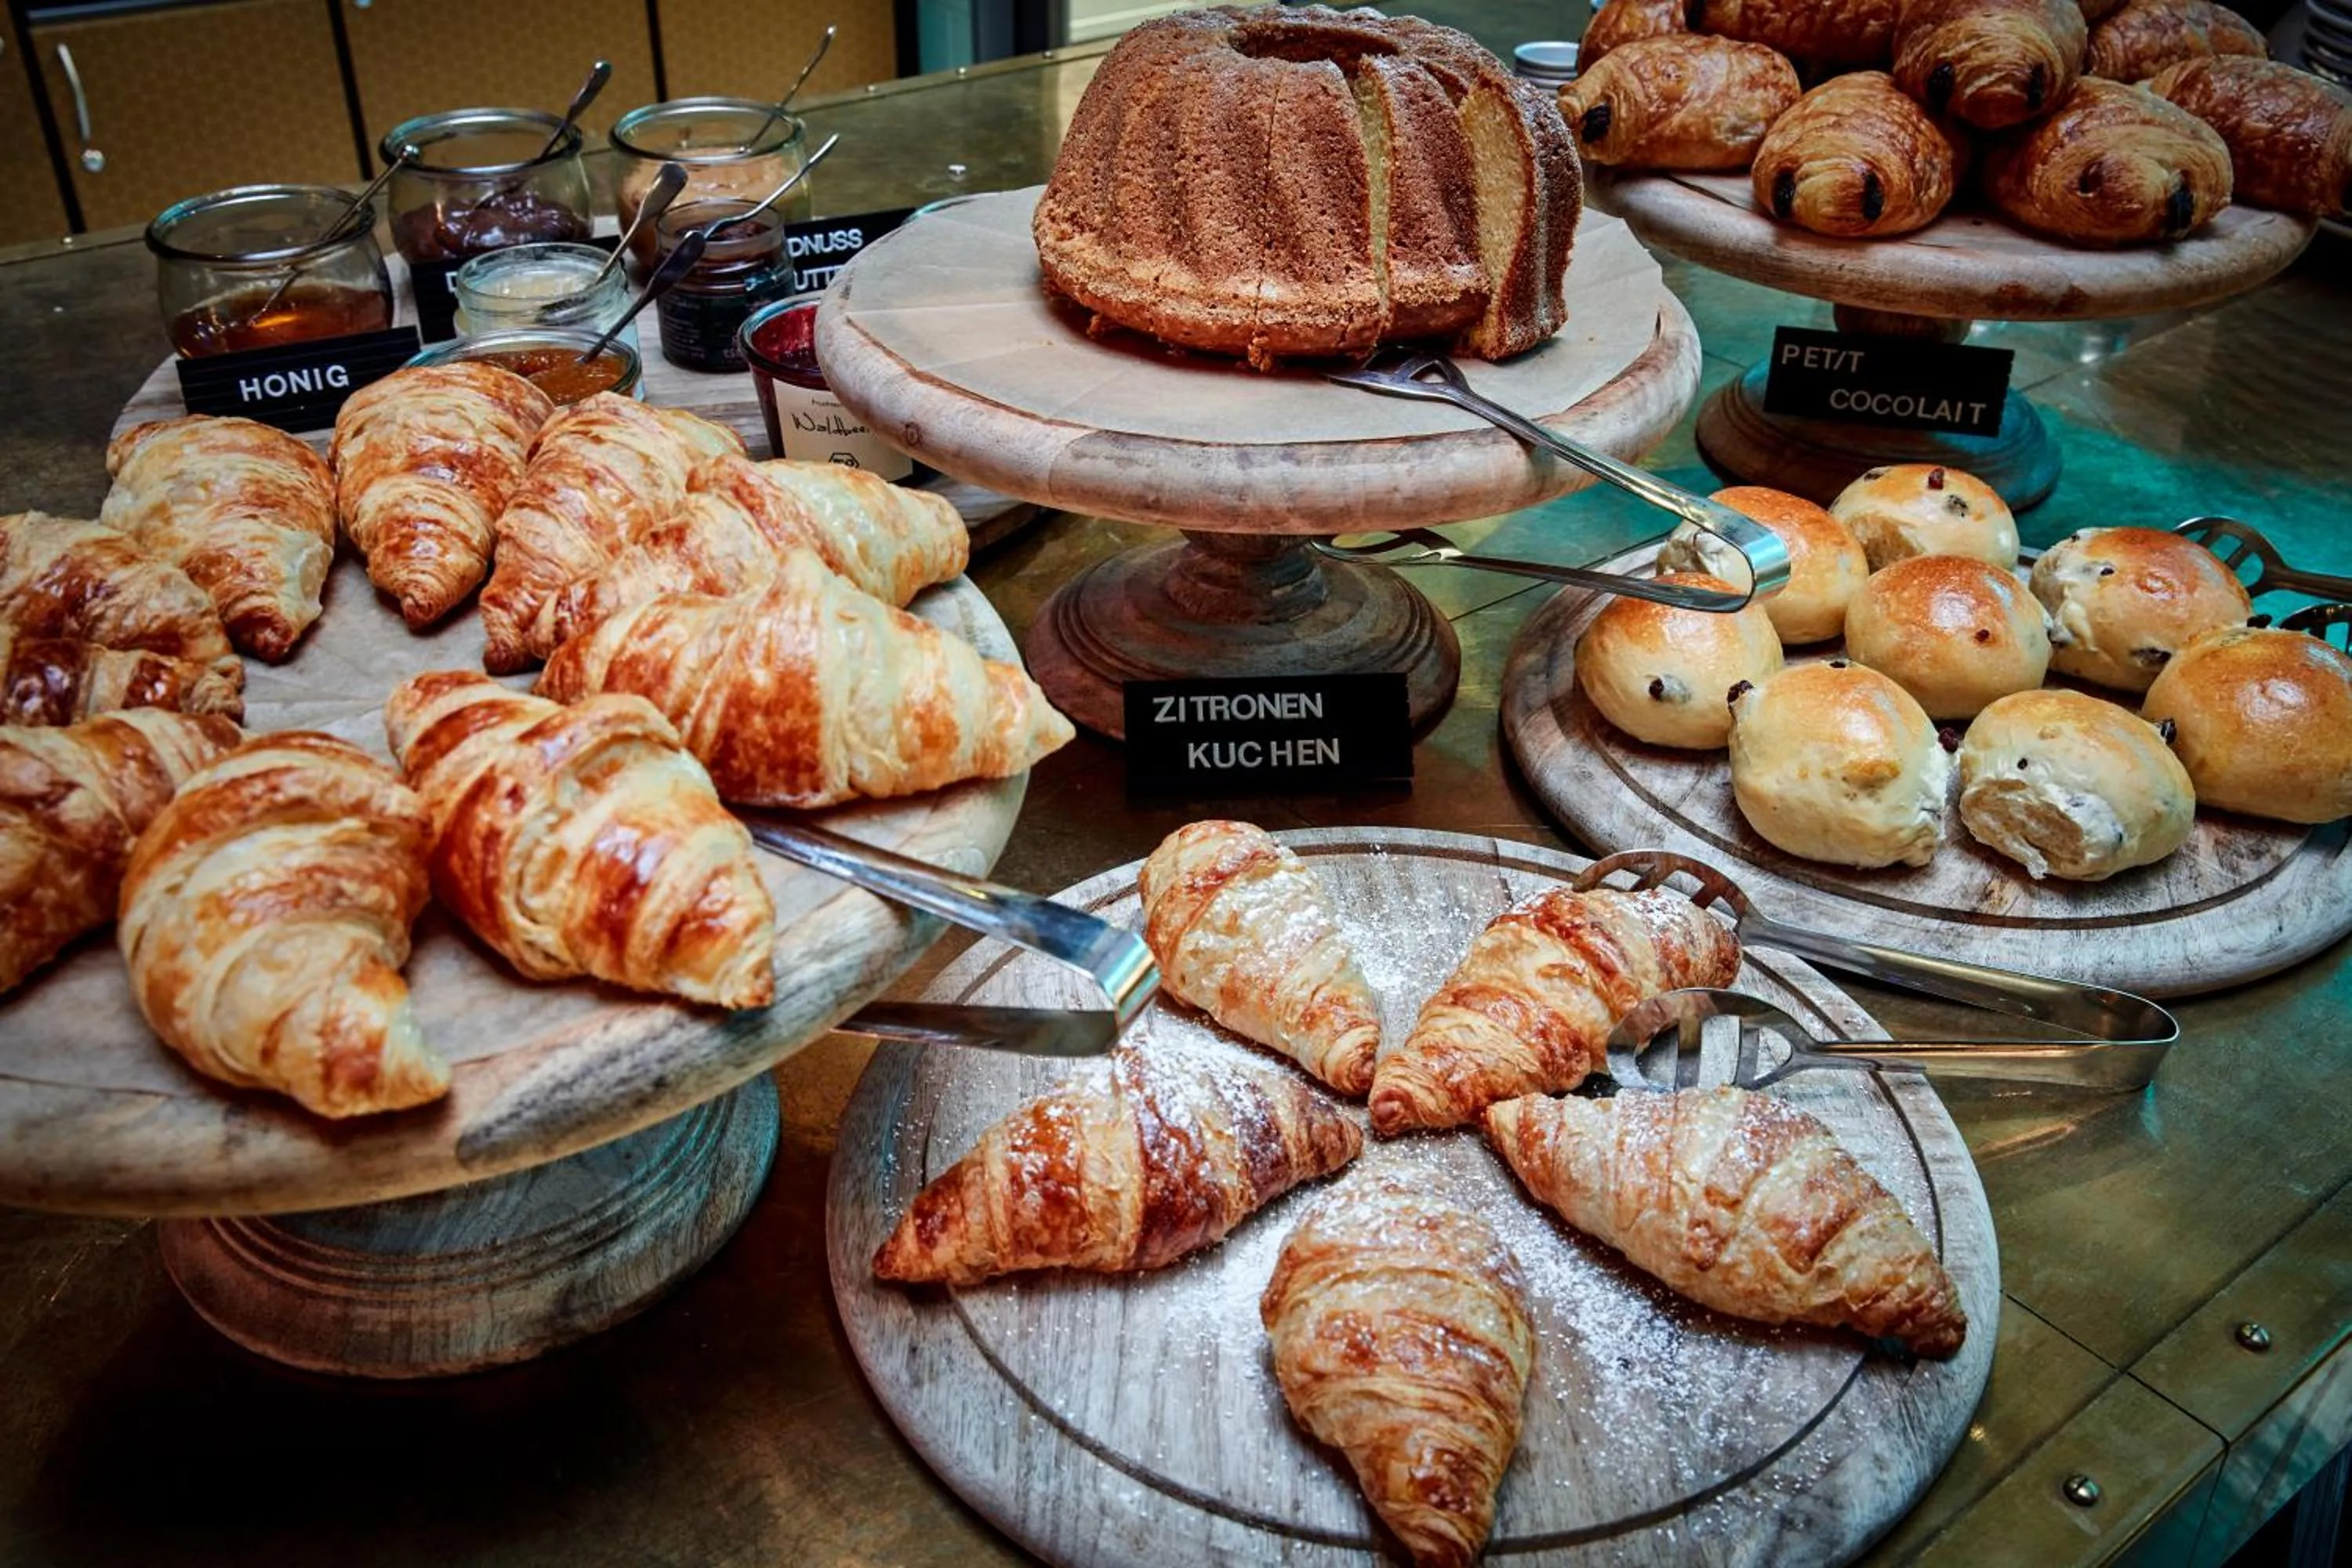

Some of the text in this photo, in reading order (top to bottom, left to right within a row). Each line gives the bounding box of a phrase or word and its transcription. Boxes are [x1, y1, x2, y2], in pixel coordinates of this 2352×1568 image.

[786, 228, 863, 258] DNUSS
[239, 365, 350, 402] HONIG
[1829, 388, 1987, 425] COCOLAIT
[792, 412, 869, 437] Waldbee
[1152, 692, 1323, 723] ZITRONEN
